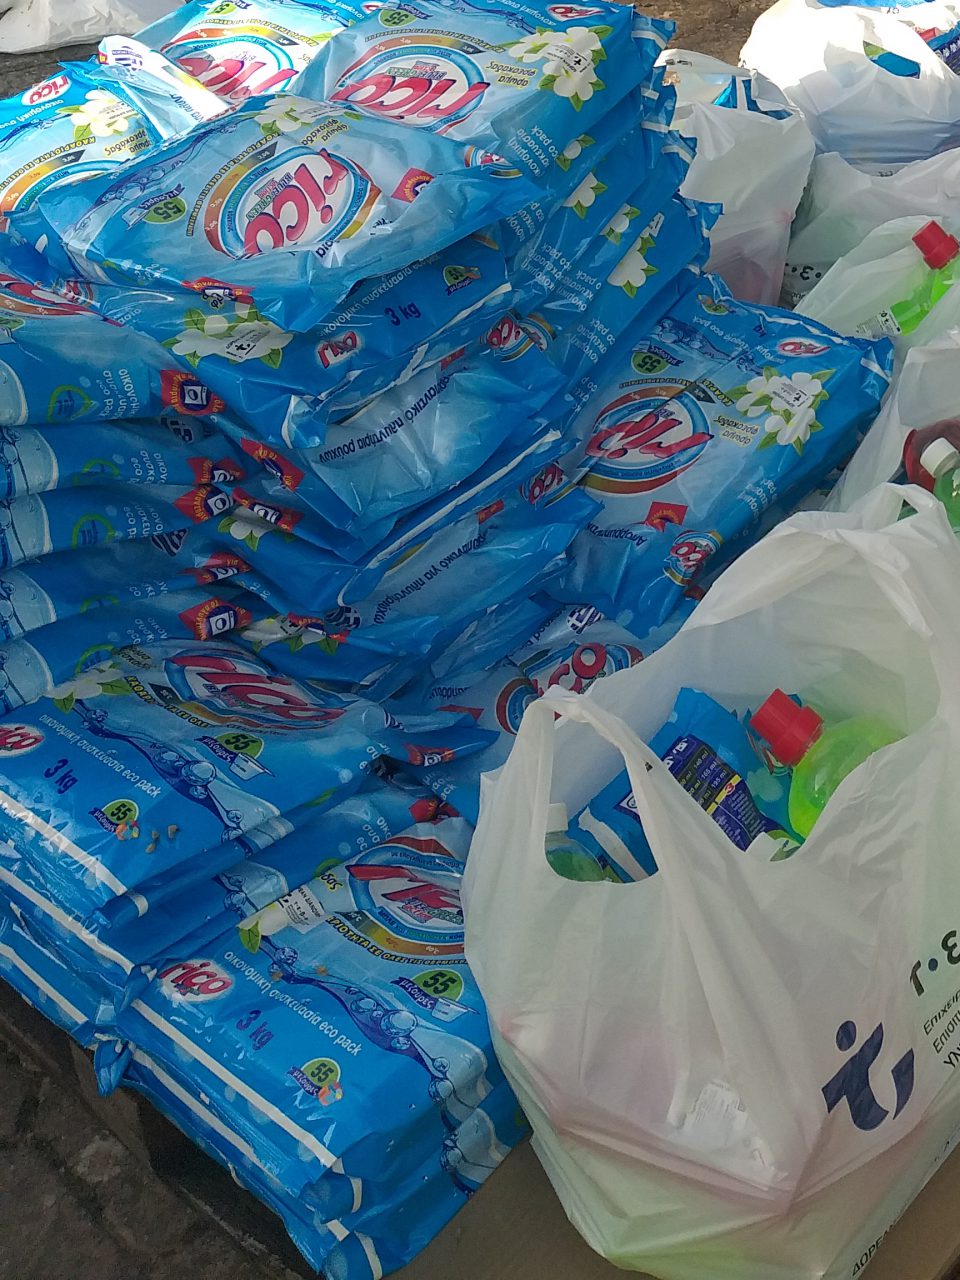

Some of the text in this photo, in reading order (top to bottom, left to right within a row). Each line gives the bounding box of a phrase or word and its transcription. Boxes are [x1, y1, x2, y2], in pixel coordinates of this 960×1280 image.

[29, 75, 69, 105] rico
[330, 73, 491, 121] rico
[153, 200, 183, 220] 55
[244, 148, 350, 257] rico
[385, 302, 422, 326] 3 kg
[637, 354, 661, 371] 55
[318, 439, 356, 464] ρούχων
[423, 562, 440, 582] για
[224, 733, 255, 751] 55
[44, 758, 79, 795] 3 kg
[122, 770, 140, 783] eco
[134, 778, 163, 799] pack
[110, 803, 133, 821] 55
[369, 945, 382, 957] ΣΕ
[157, 961, 234, 995] rico
[422, 971, 458, 995] 55
[223, 951, 364, 1057] οικονομική συσκευασία eco pack
[399, 979, 434, 1010] μεζούρες
[236, 1009, 275, 1052] 3 kg
[292, 1068, 320, 1098] μεζούρες
[310, 1063, 333, 1084] 55
